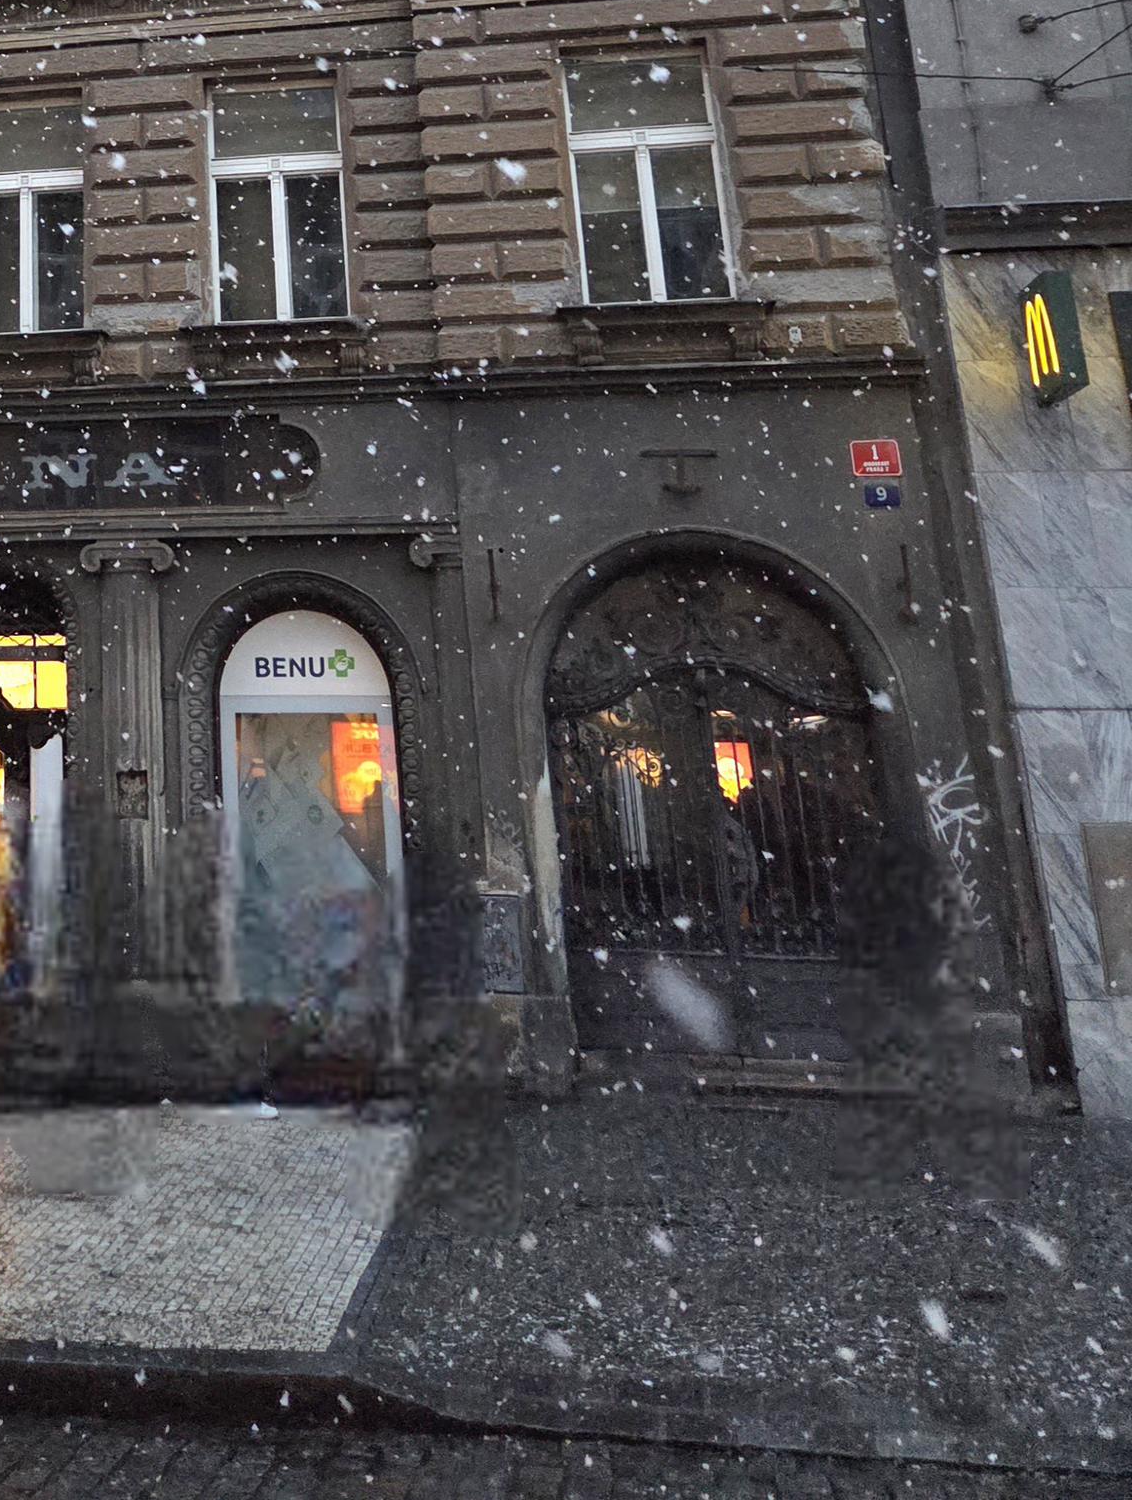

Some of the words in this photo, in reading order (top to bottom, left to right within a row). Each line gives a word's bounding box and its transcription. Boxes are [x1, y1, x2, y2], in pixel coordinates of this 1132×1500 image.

[871, 444, 879, 460] 1
[876, 486, 887, 501] 9
[254, 657, 325, 678] BENU
